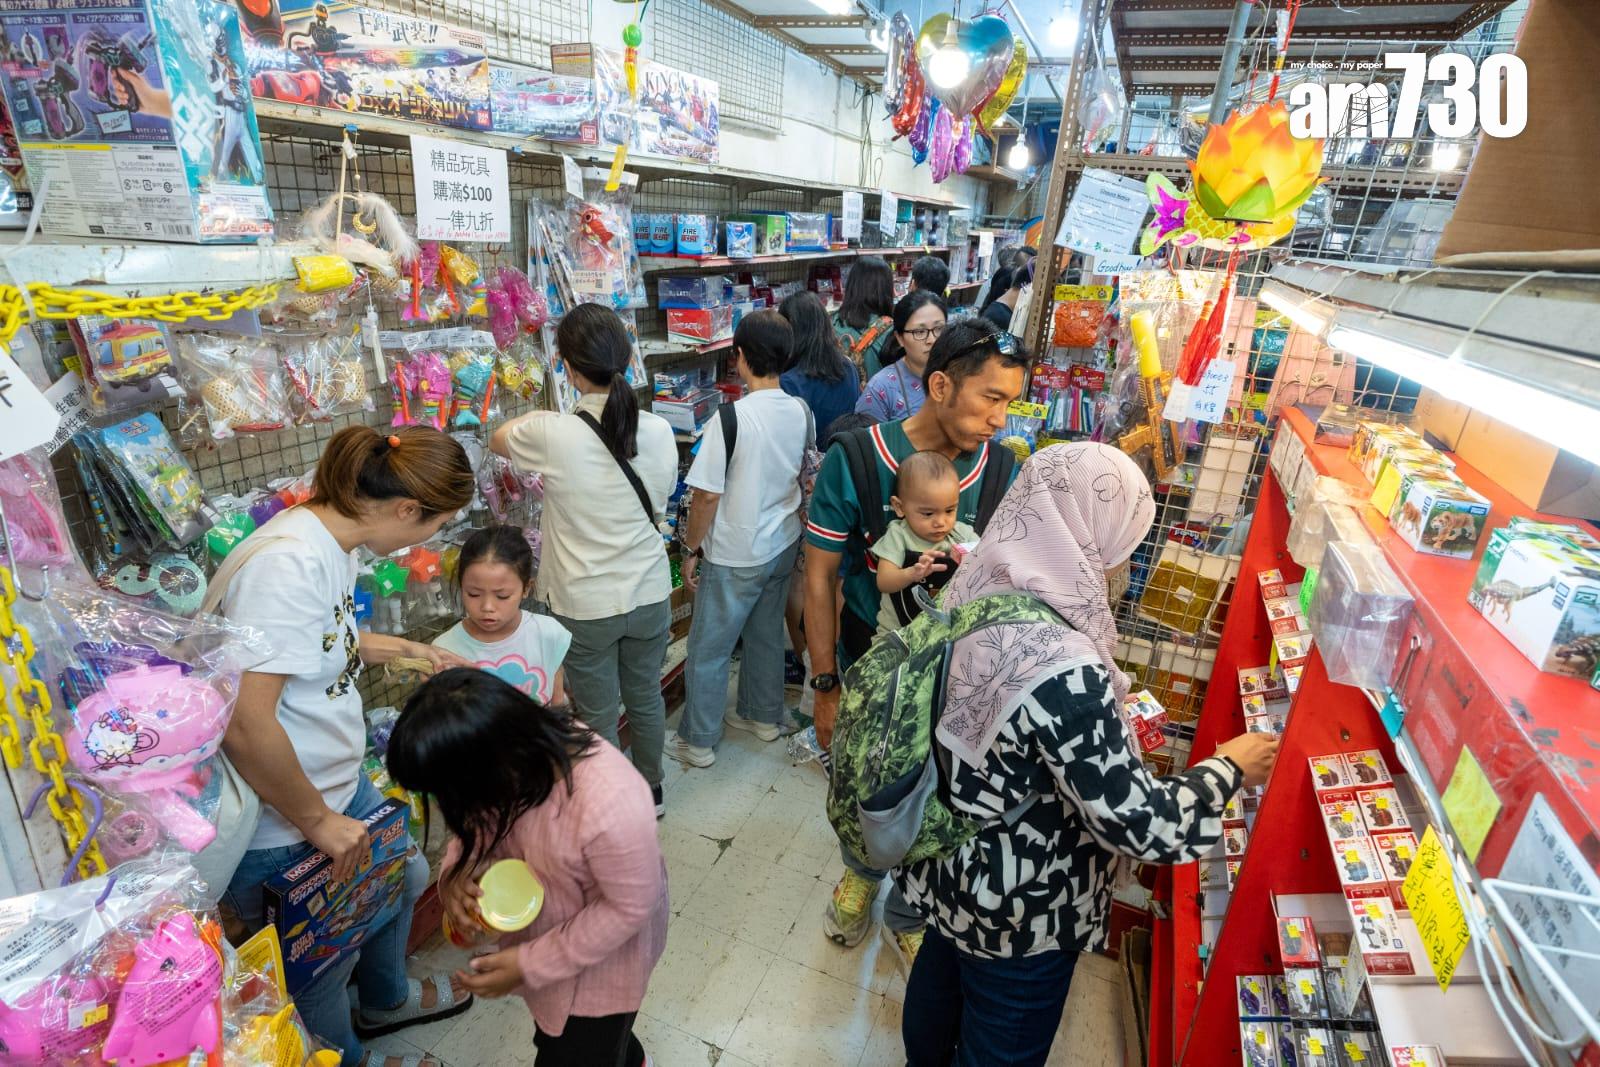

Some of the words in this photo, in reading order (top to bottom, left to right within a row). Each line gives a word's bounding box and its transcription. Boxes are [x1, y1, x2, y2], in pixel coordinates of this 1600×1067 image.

[430, 149, 491, 177] 精品玩具
[432, 179, 493, 203] 購滿$100
[435, 209, 494, 232] 一律九折
[654, 226, 668, 234] FIRE
